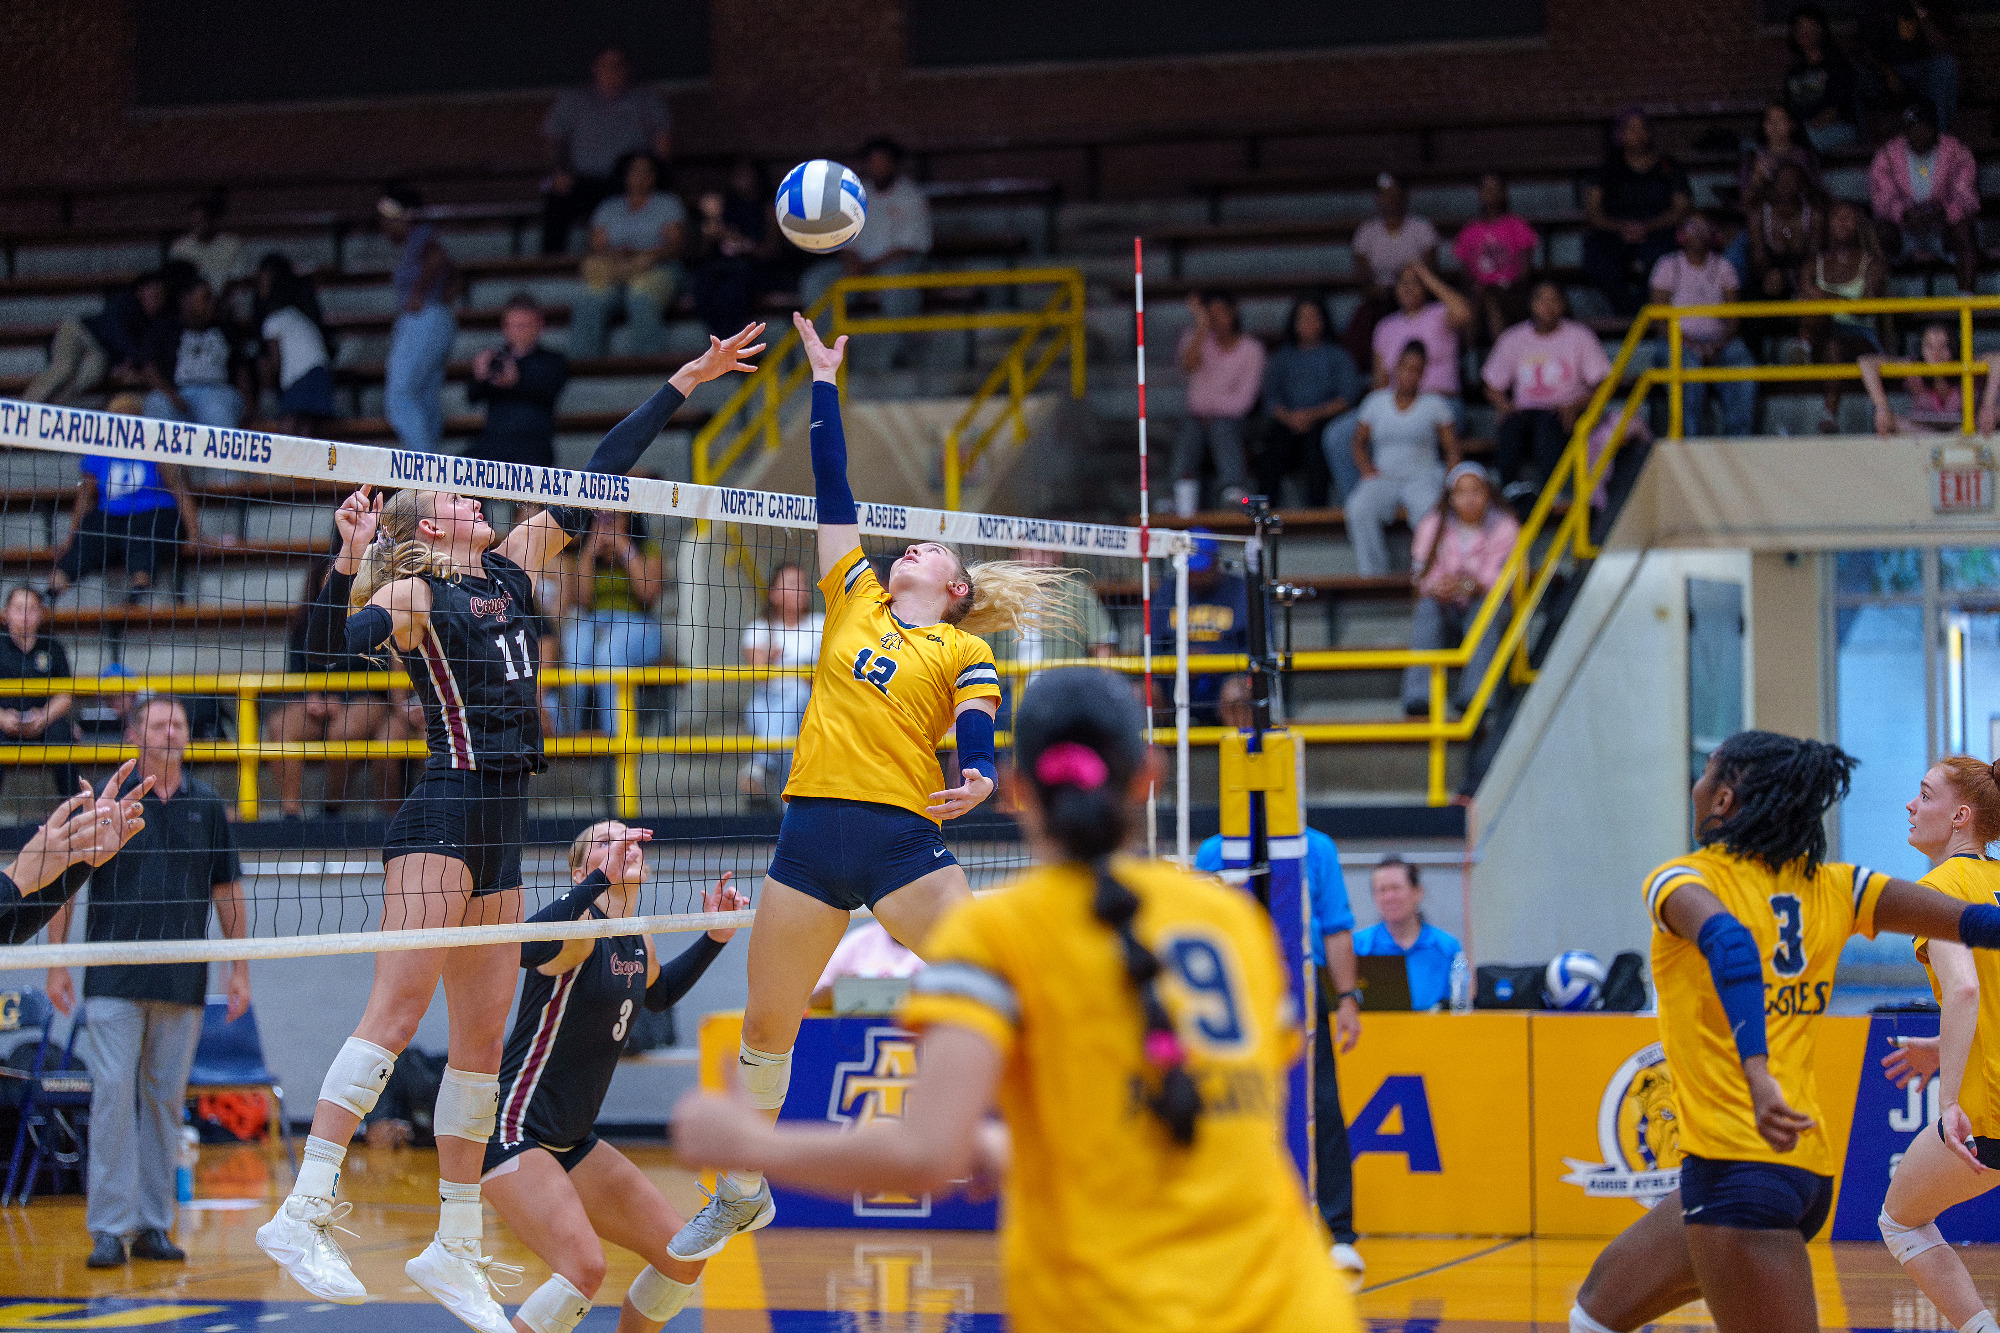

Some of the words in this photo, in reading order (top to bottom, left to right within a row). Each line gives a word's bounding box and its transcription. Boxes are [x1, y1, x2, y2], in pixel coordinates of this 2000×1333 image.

[38, 408, 146, 451] CAROLINA
[153, 421, 197, 456] A&T
[203, 428, 273, 464] AGGIES
[390, 450, 448, 484] NORTH
[452, 457, 534, 495] CAROLINA
[539, 467, 573, 498] A&T
[577, 472, 631, 503] AGGIES
[1939, 470, 1983, 508] EXIT
[720, 488, 764, 517] NORTH
[768, 494, 818, 524] CAROLI
[865, 504, 907, 530] AGGIES
[494, 629, 533, 682] 11
[851, 646, 899, 696] 12
[1768, 891, 1808, 979] 3
[1160, 932, 1248, 1048] 9
[612, 998, 633, 1042] 3
